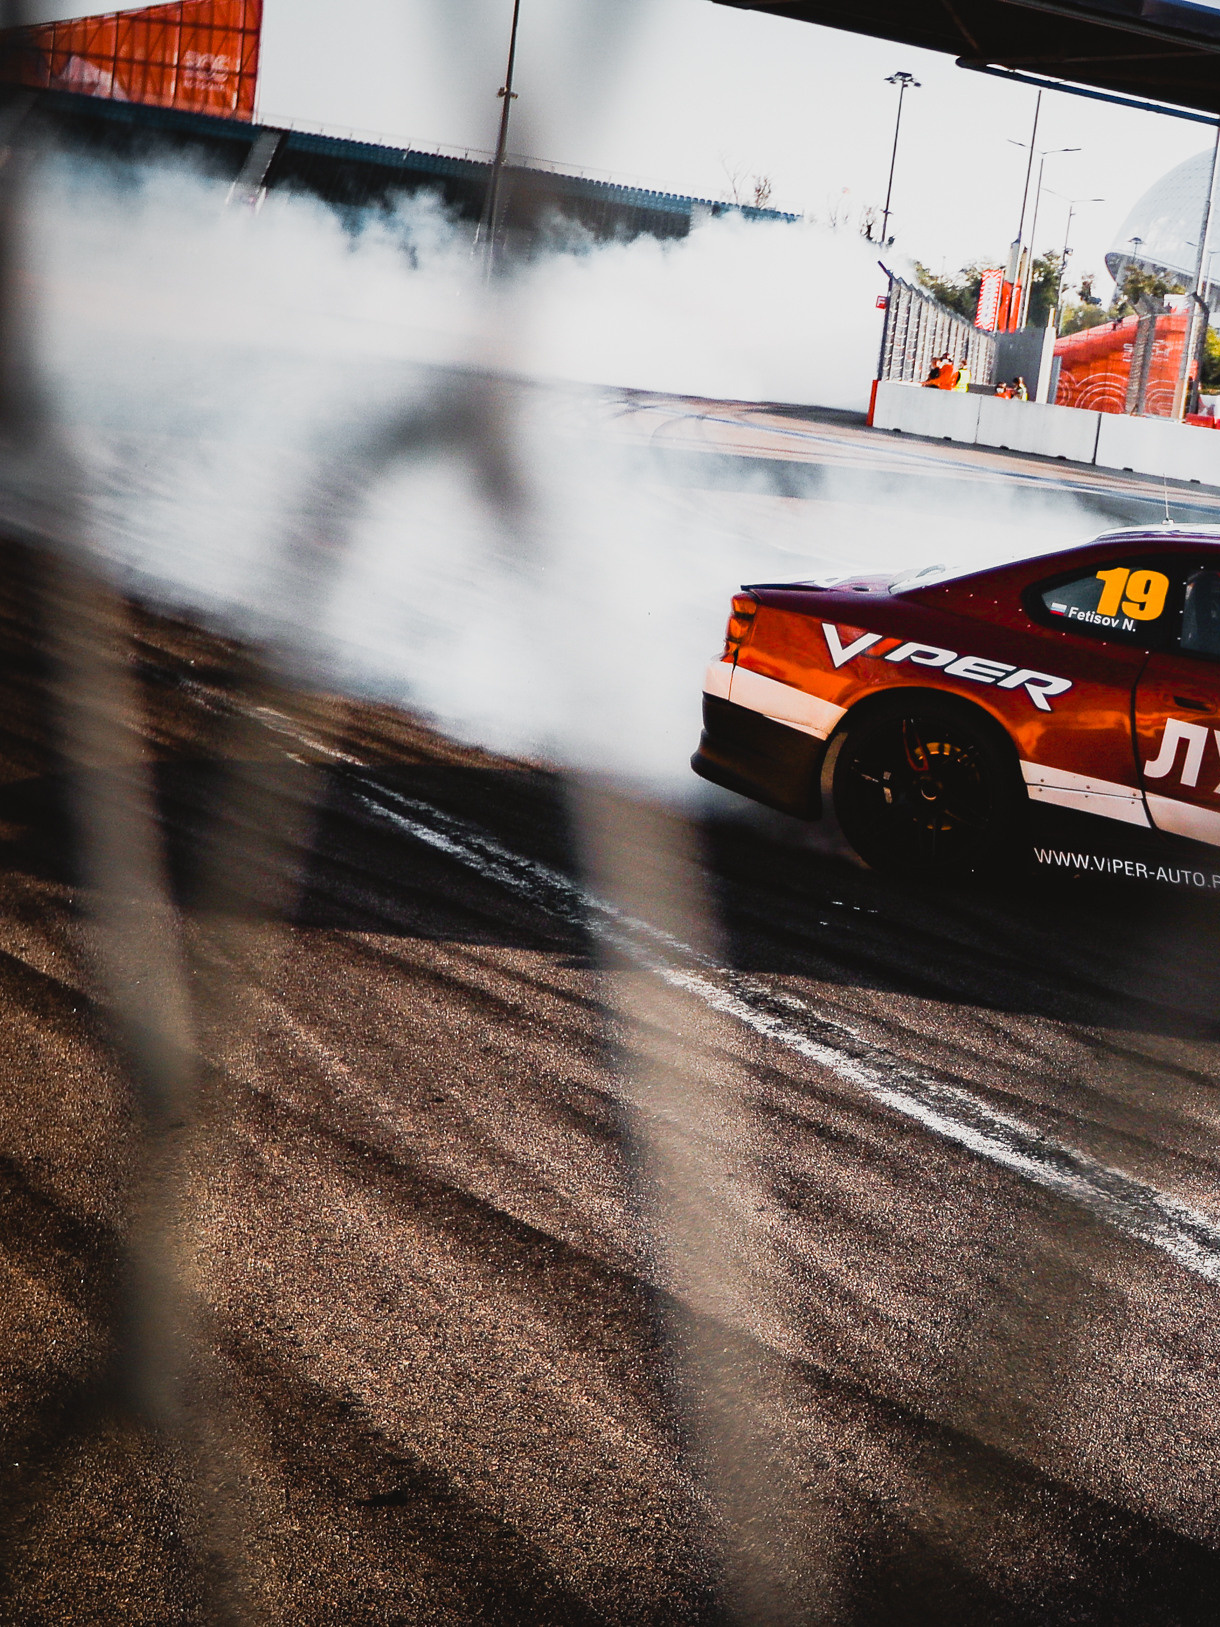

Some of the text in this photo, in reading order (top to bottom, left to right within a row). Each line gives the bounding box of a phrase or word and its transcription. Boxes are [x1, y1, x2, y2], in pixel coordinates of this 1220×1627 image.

[1068, 606, 1136, 632] Fetisov N.
[1096, 567, 1170, 621] 19
[822, 622, 1073, 712] VIPER
